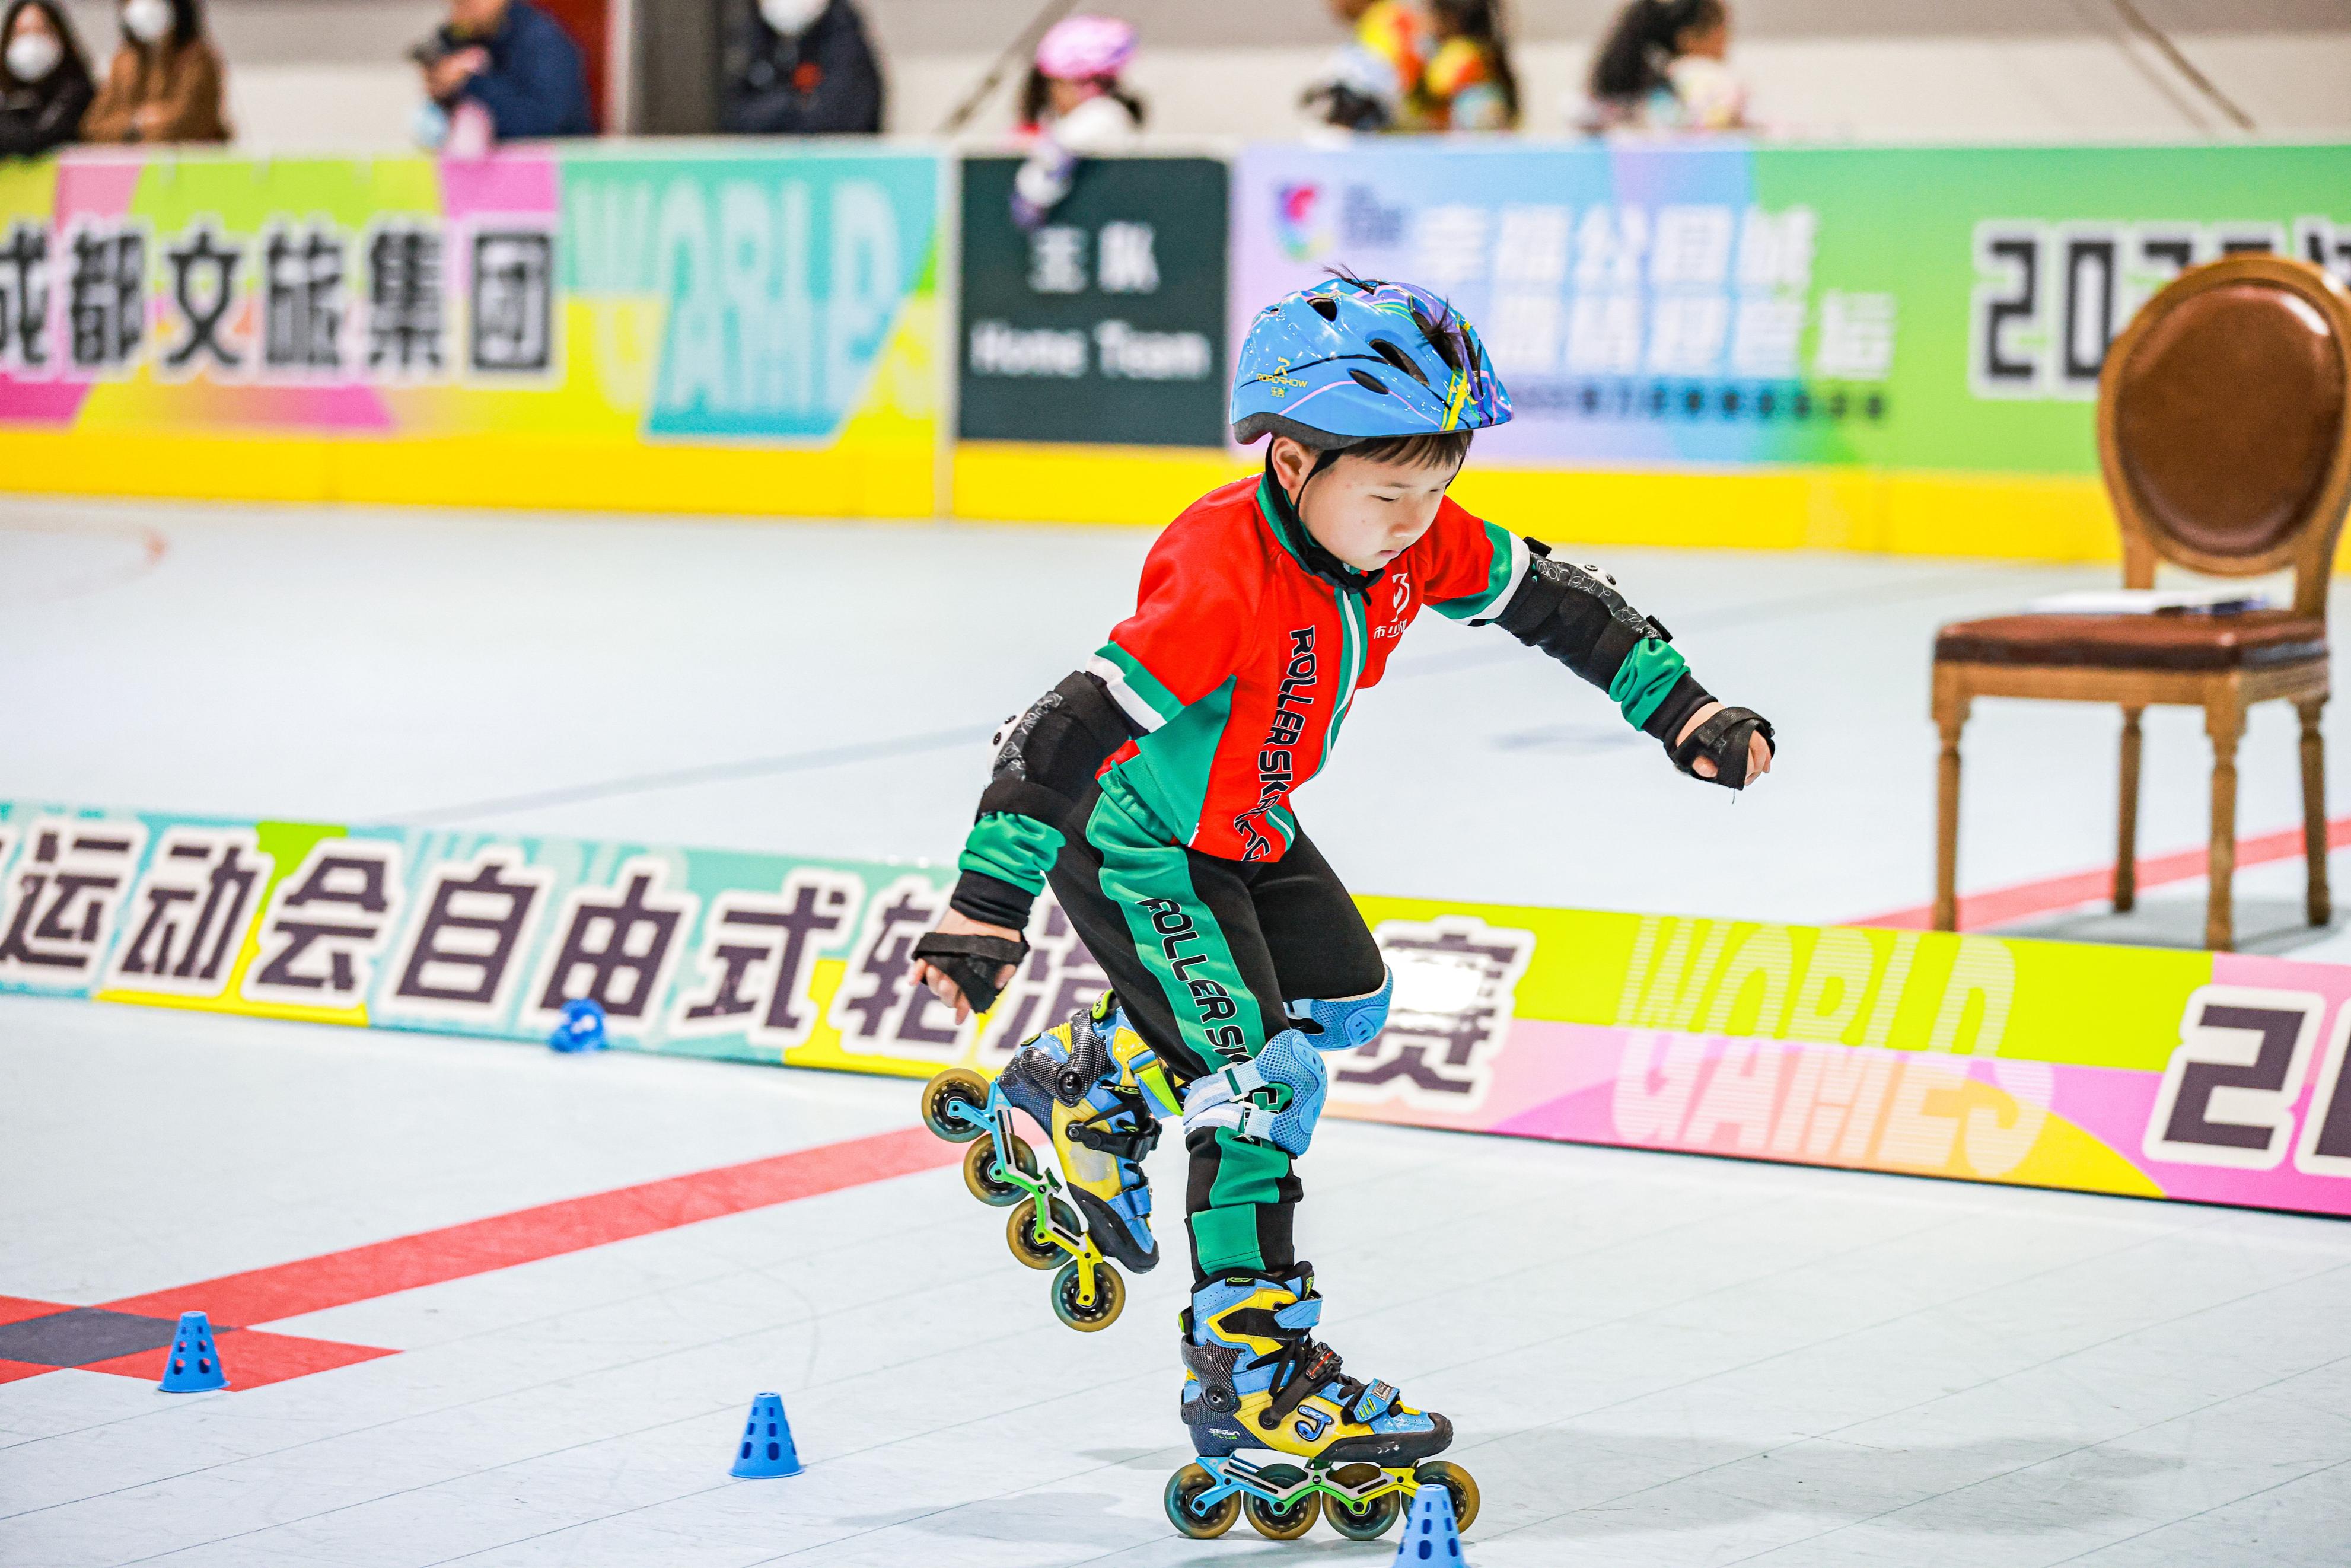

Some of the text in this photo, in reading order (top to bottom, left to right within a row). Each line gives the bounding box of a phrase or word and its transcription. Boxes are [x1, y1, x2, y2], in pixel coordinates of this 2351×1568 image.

[1263, 625, 1317, 746] ROLLER
[1135, 898, 1238, 1024] ROLLER
[1609, 914, 2015, 1059] WORLD
[1612, 1029, 2054, 1179] GAMES
